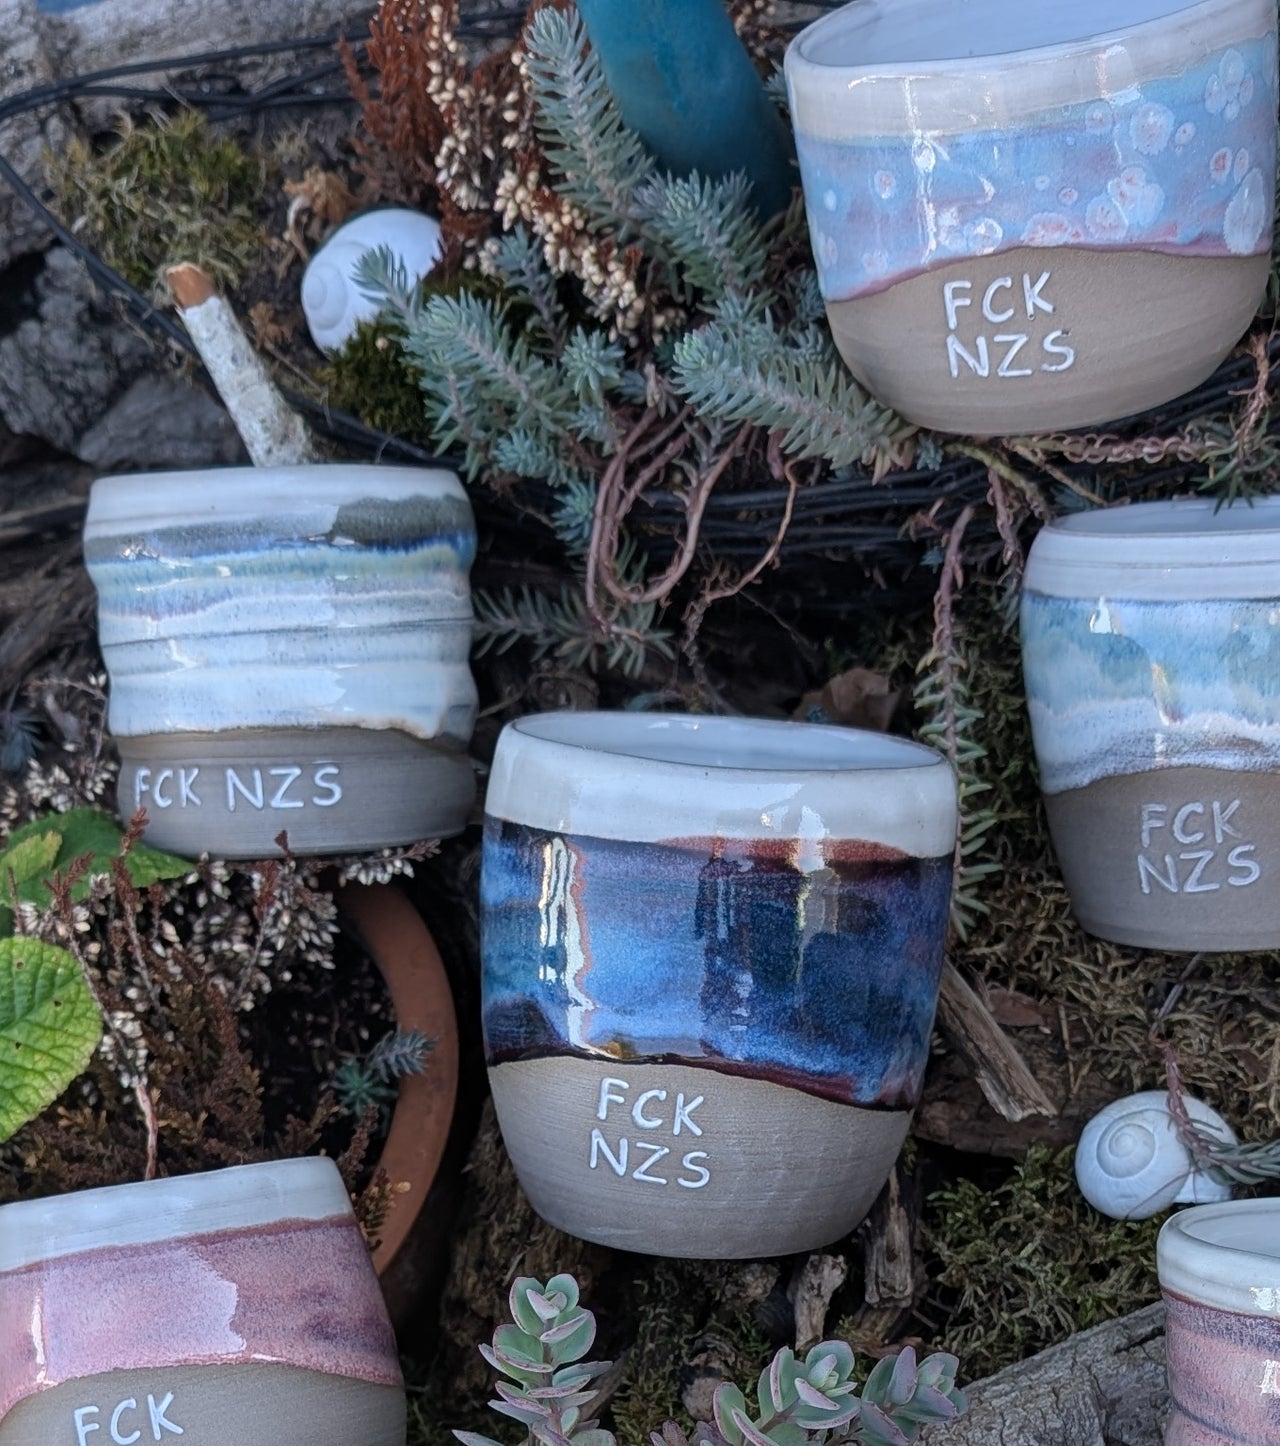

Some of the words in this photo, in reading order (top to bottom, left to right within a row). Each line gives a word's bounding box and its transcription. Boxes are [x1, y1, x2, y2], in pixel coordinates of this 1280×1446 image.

[944, 271, 1056, 328] FCK
[946, 330, 1076, 379] NZS
[134, 772, 202, 809] FCK
[225, 765, 344, 810] NZS
[1141, 799, 1243, 848] FCK
[1138, 845, 1261, 894] NZS
[598, 1076, 705, 1137] FCK
[588, 1128, 713, 1189] NZS
